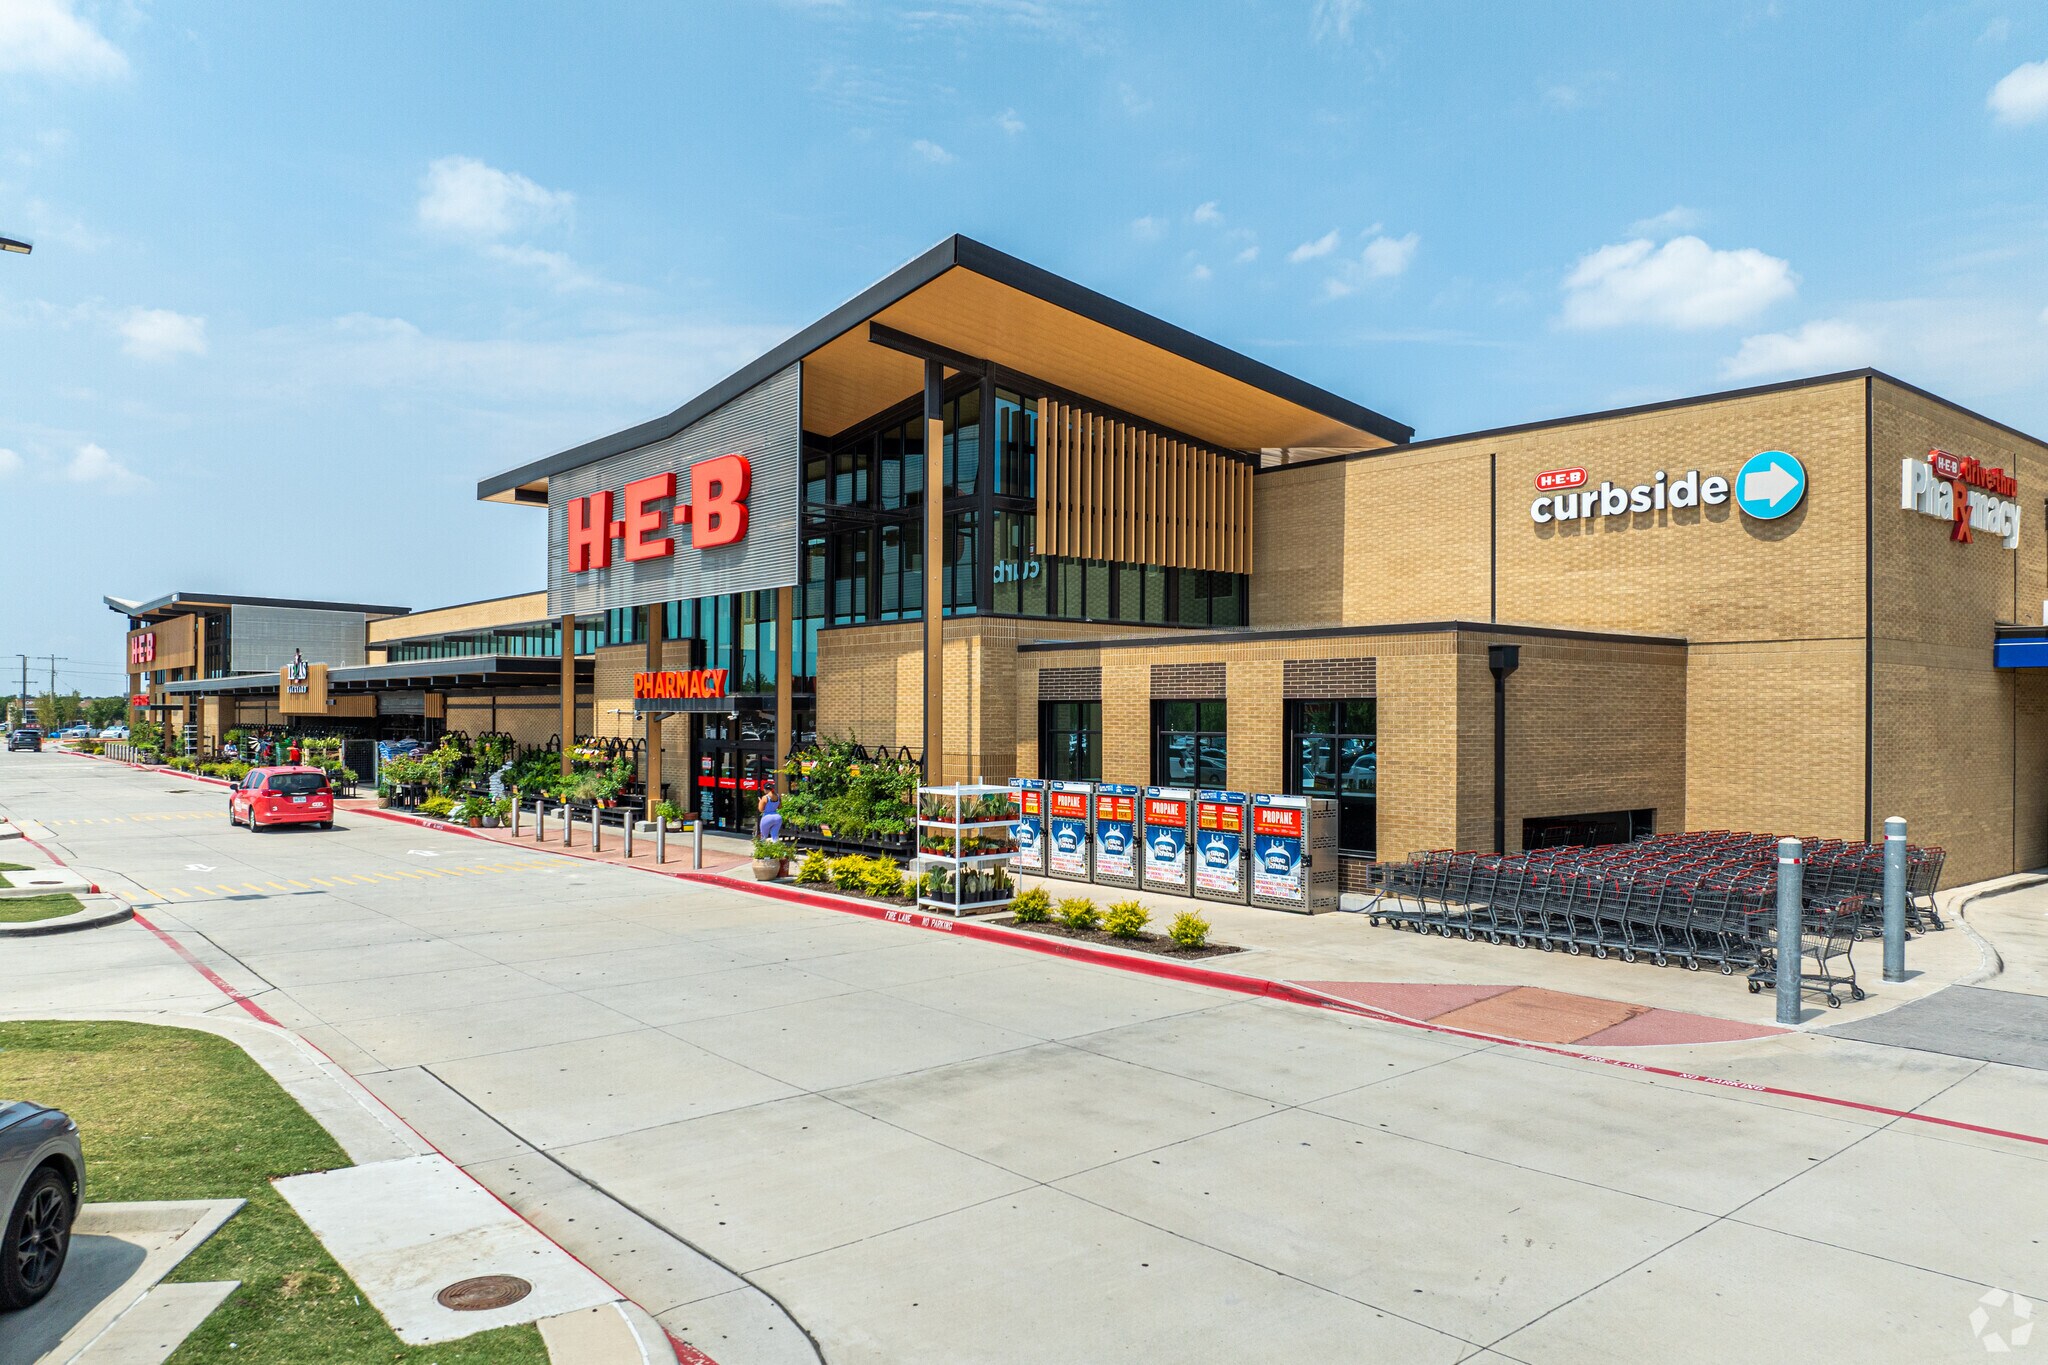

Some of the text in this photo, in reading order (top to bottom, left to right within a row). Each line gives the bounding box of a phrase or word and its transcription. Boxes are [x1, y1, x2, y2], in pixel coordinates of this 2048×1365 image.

[1963, 455, 2018, 498] drive-thru
[1530, 470, 1729, 523] curbside
[633, 669, 729, 699] PHARMACY
[1057, 795, 1081, 808] PROPANE
[1152, 801, 1179, 815] PROPANE
[1262, 810, 1293, 825] PROPANE
[884, 910, 953, 931] FIRE LANE NO PARKING
[1704, 1077, 1766, 1091] PARKING
